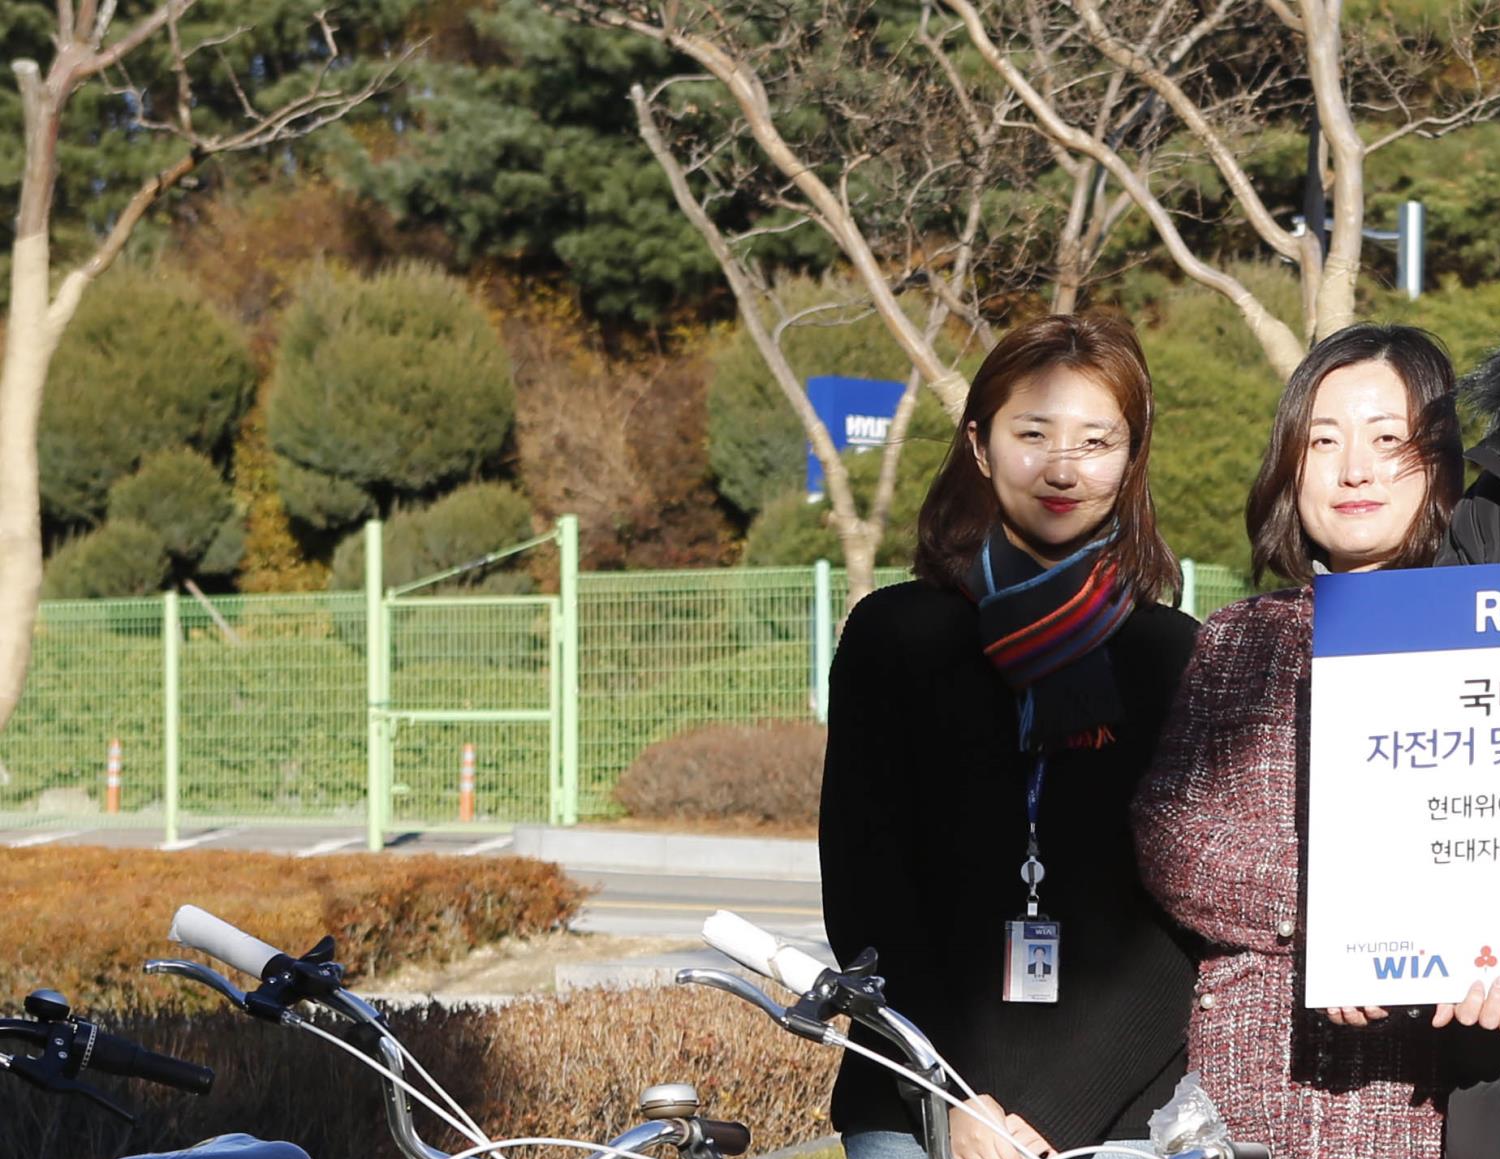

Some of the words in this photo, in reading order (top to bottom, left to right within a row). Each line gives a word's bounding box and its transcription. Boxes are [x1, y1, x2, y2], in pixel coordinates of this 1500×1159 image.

[1367, 727, 1474, 769] 자전거
[1346, 941, 1414, 953] HYUNDAI
[1373, 952, 1449, 980] WIA
